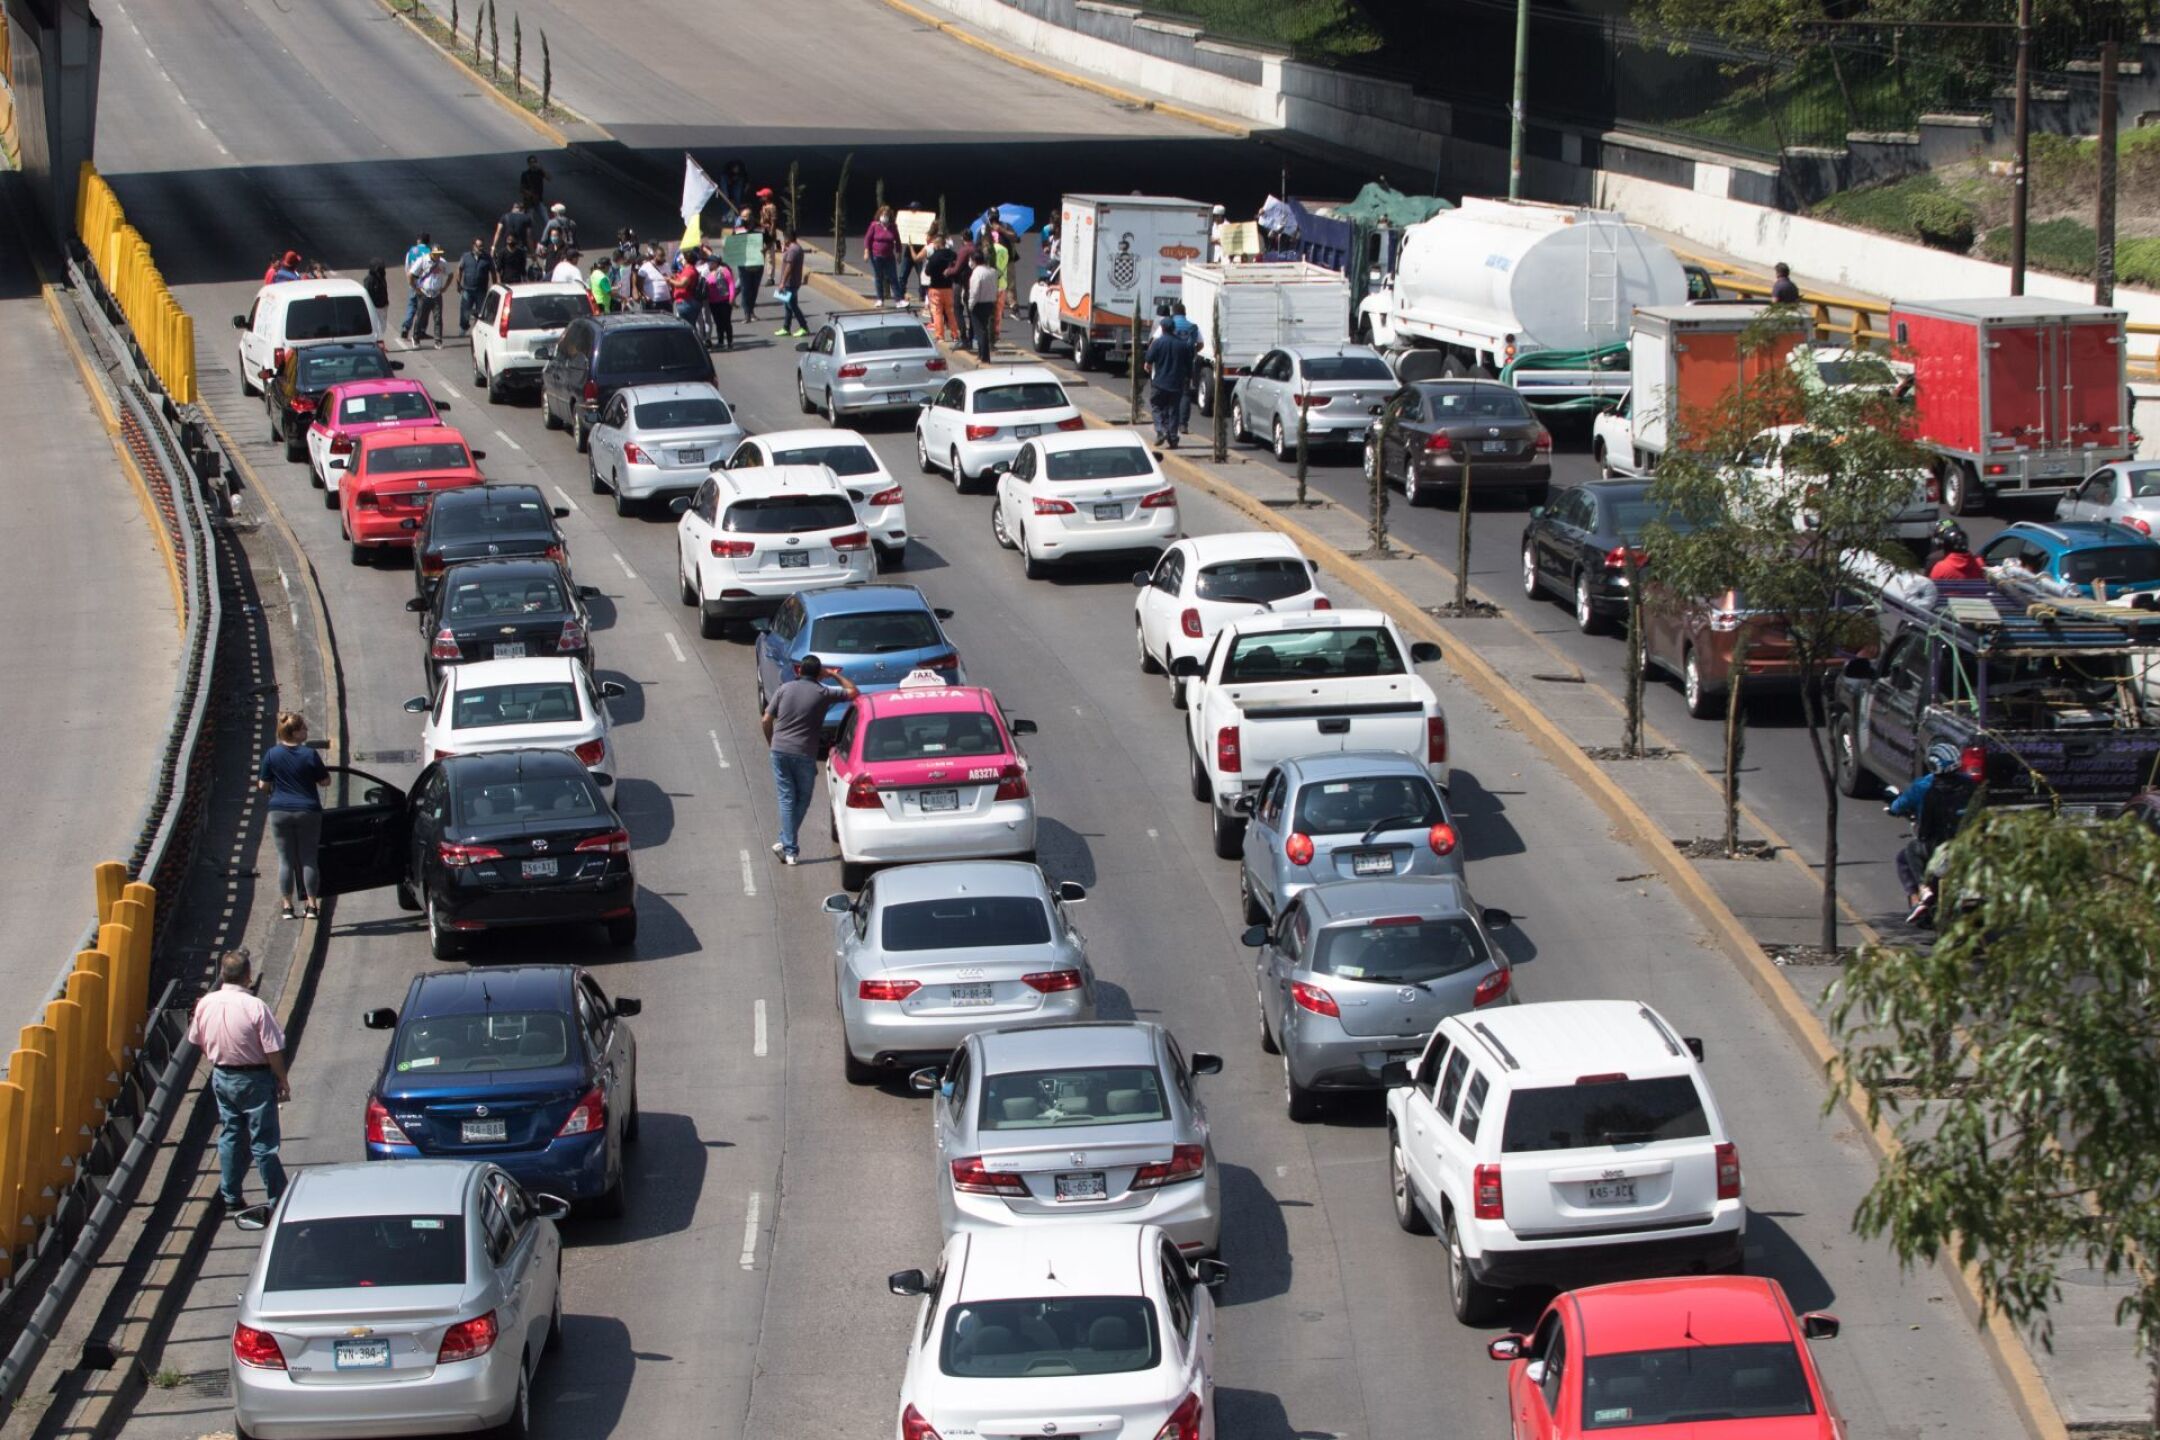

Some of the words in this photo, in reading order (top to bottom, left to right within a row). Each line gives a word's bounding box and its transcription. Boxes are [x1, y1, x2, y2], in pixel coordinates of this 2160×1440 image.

[913, 671, 933, 679] TAXI
[889, 690, 965, 701] A8327A
[968, 768, 999, 780] A8327A
